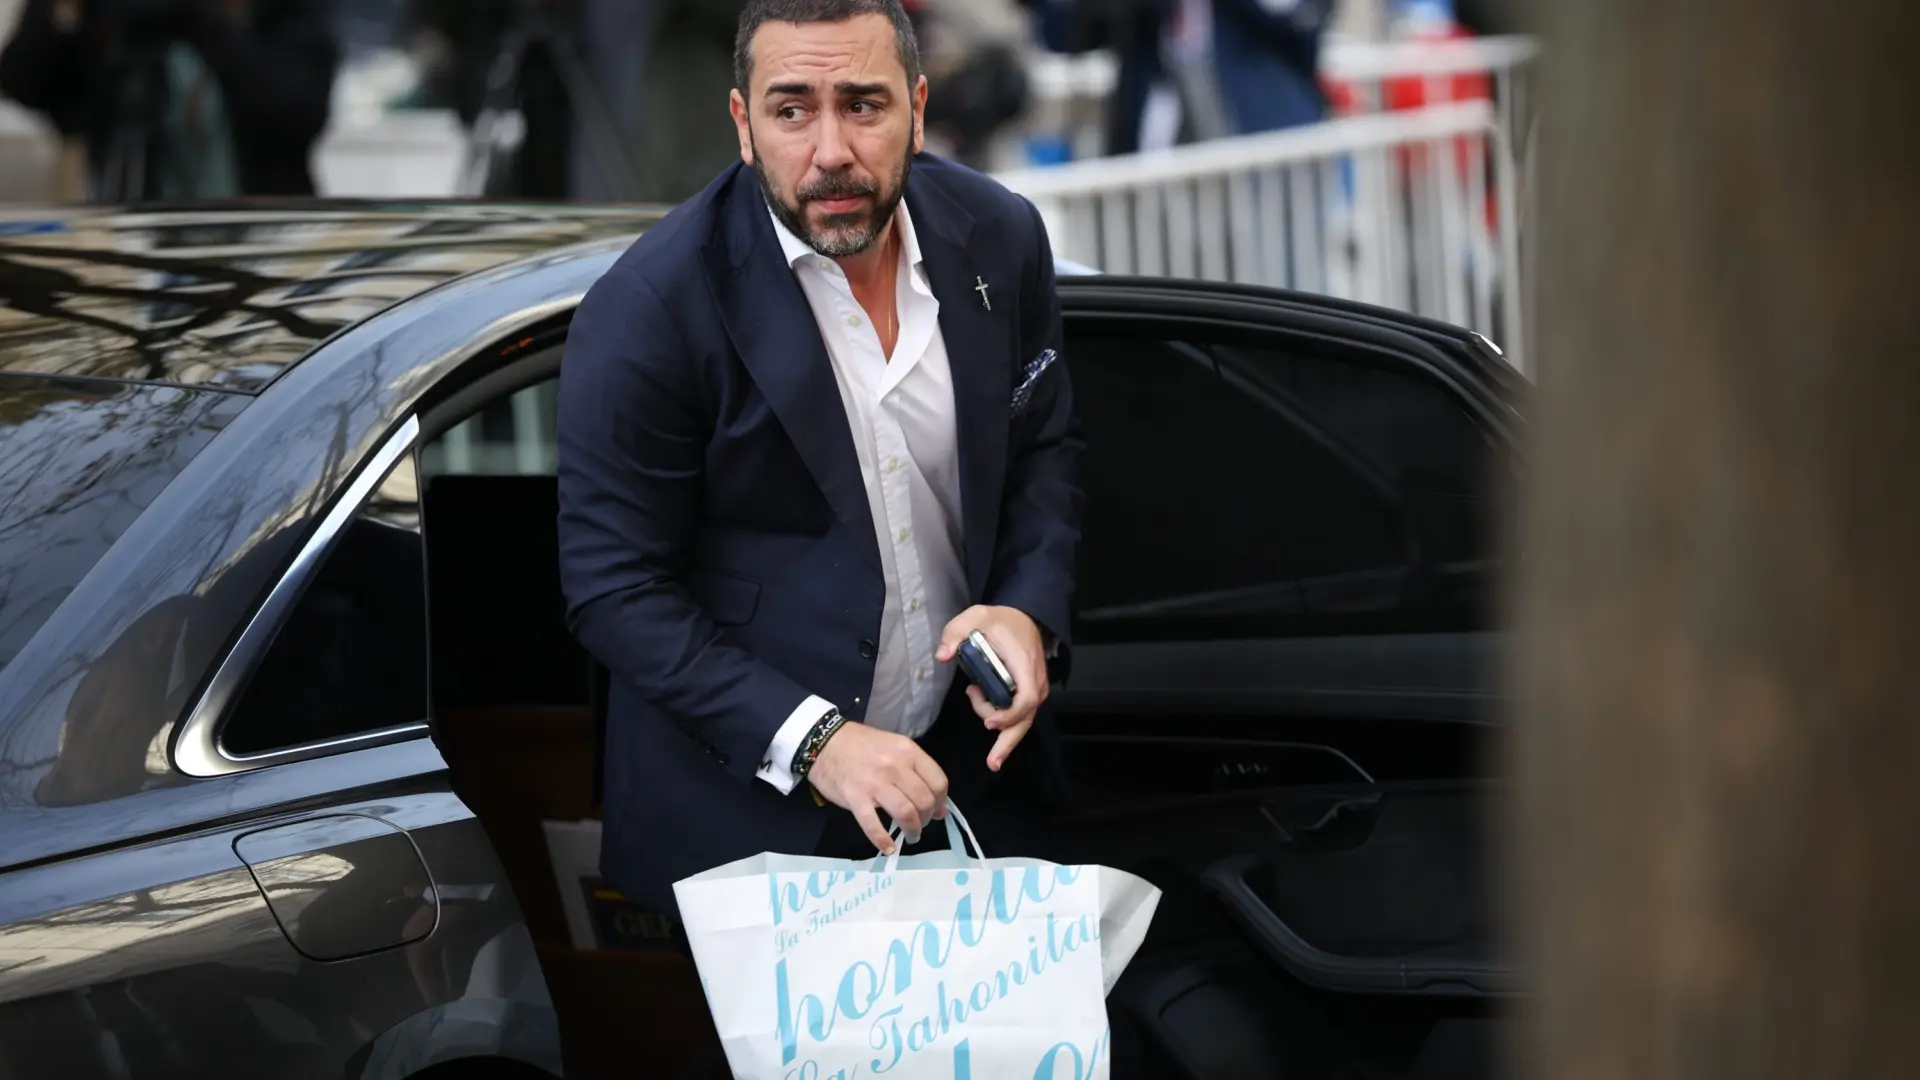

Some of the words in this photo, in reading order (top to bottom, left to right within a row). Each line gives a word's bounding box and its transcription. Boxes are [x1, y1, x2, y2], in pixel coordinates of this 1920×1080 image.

[774, 930, 801, 954] La
[805, 873, 896, 936] Tahonita
[869, 911, 1100, 1074] Tahonita
